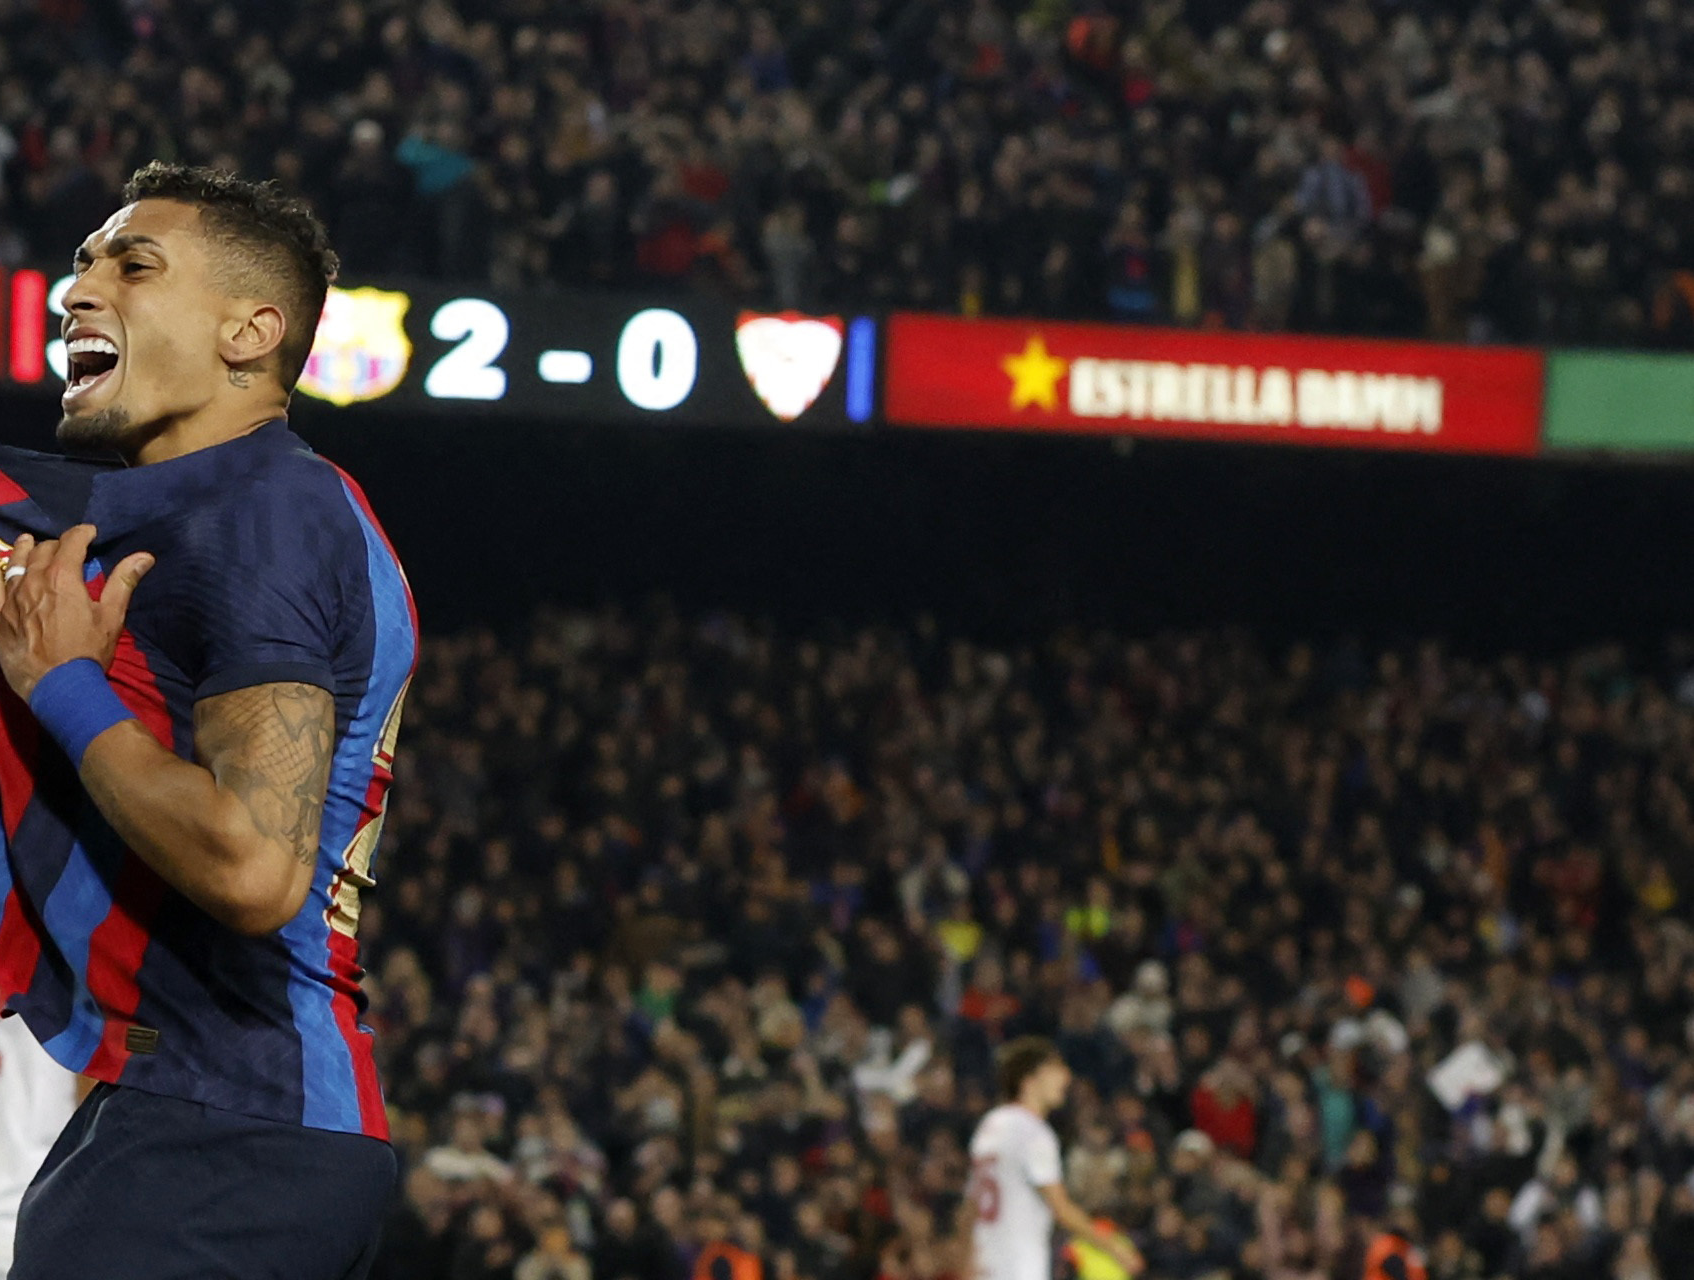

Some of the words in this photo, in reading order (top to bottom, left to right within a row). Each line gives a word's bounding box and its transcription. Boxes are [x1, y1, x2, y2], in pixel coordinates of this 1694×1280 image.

[427, 299, 507, 399] 2
[618, 310, 696, 409] 0
[1069, 357, 1295, 424] ESTRELLA
[1294, 369, 1441, 432] DAMM
